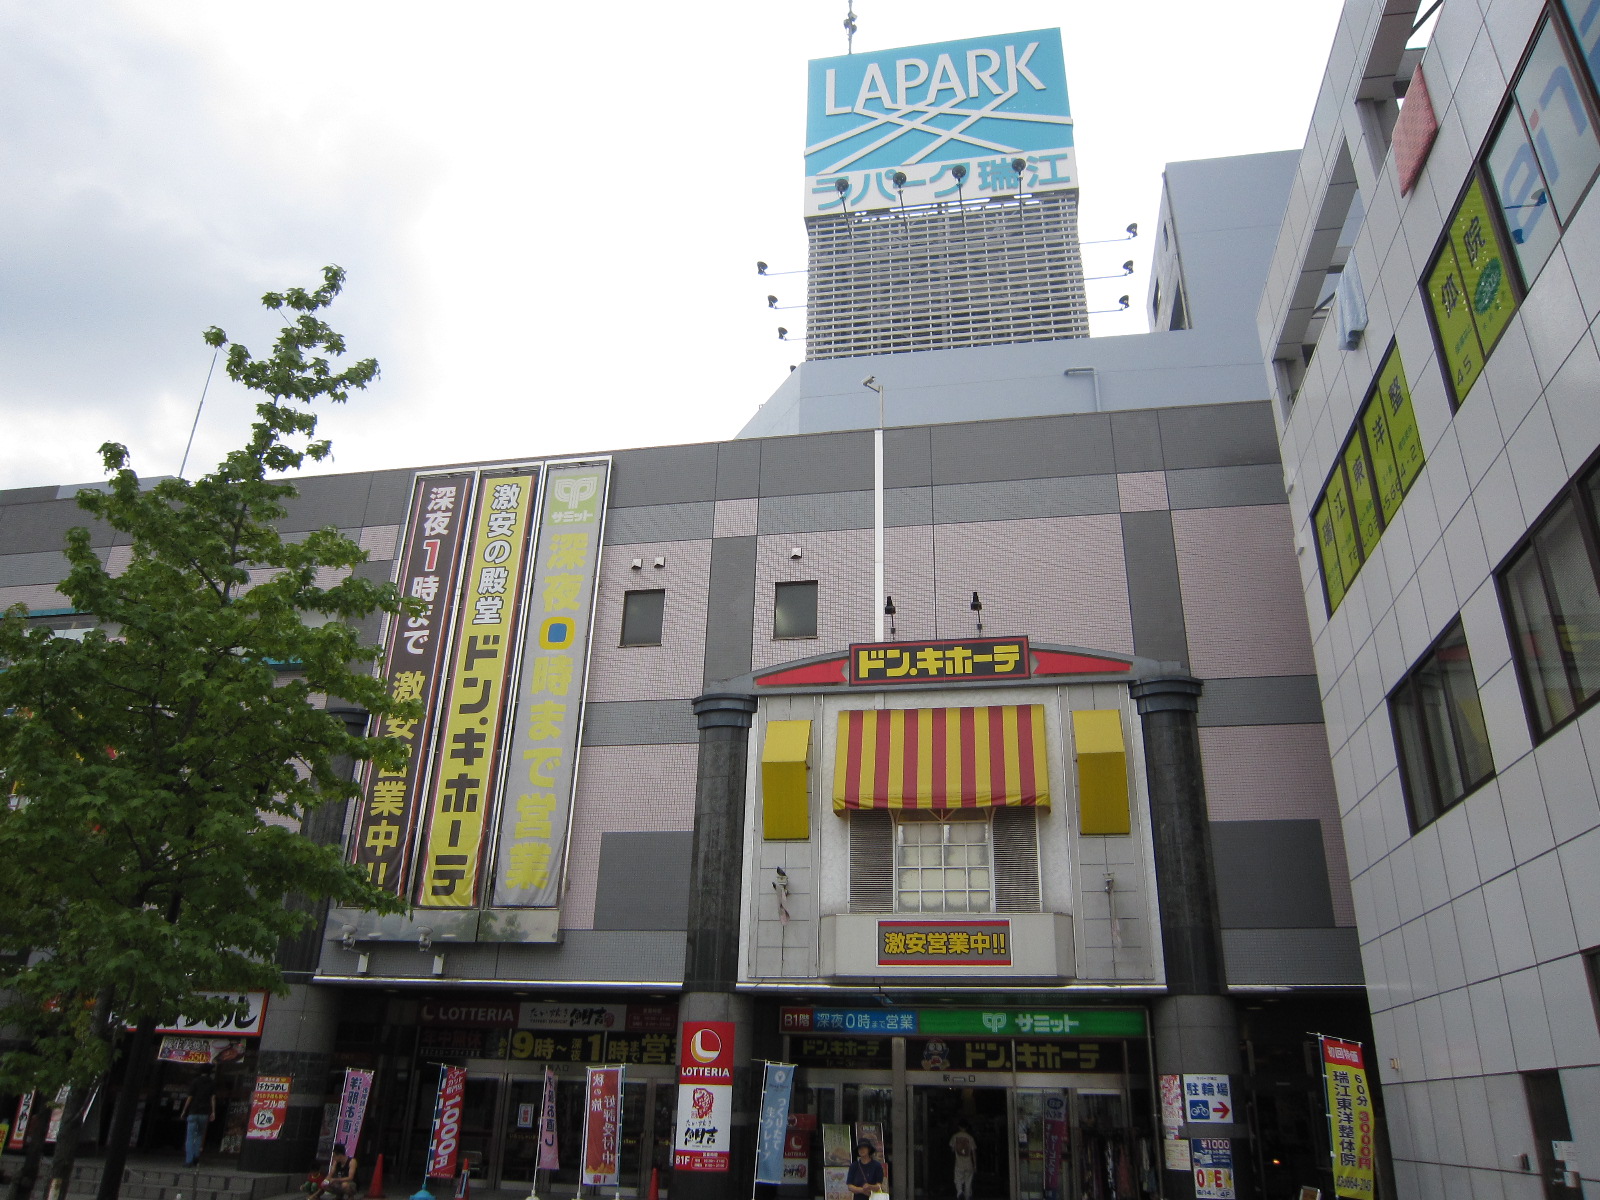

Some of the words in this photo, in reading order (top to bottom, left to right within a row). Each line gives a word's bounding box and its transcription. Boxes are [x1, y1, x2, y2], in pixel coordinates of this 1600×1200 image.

[826, 42, 1047, 116] LAPARK
[812, 153, 1071, 210] ラパーク瑞江
[551, 511, 594, 523] サミット
[472, 483, 522, 625] 激安の殿堂
[884, 931, 1007, 954] 激安営業中!!
[438, 1007, 514, 1022] LOTTERIA
[817, 1013, 914, 1030] 深夜0時まで営業
[1015, 1013, 1079, 1033] サミット
[681, 1067, 730, 1077] LOTTERIA
[256, 1082, 288, 1092] チカラめし
[1186, 1082, 1229, 1097] 駐輪場
[1332, 1071, 1357, 1166] 瑞江東洋整体院
[675, 1155, 691, 1165] B1F
[1196, 1168, 1233, 1188] OPEN
